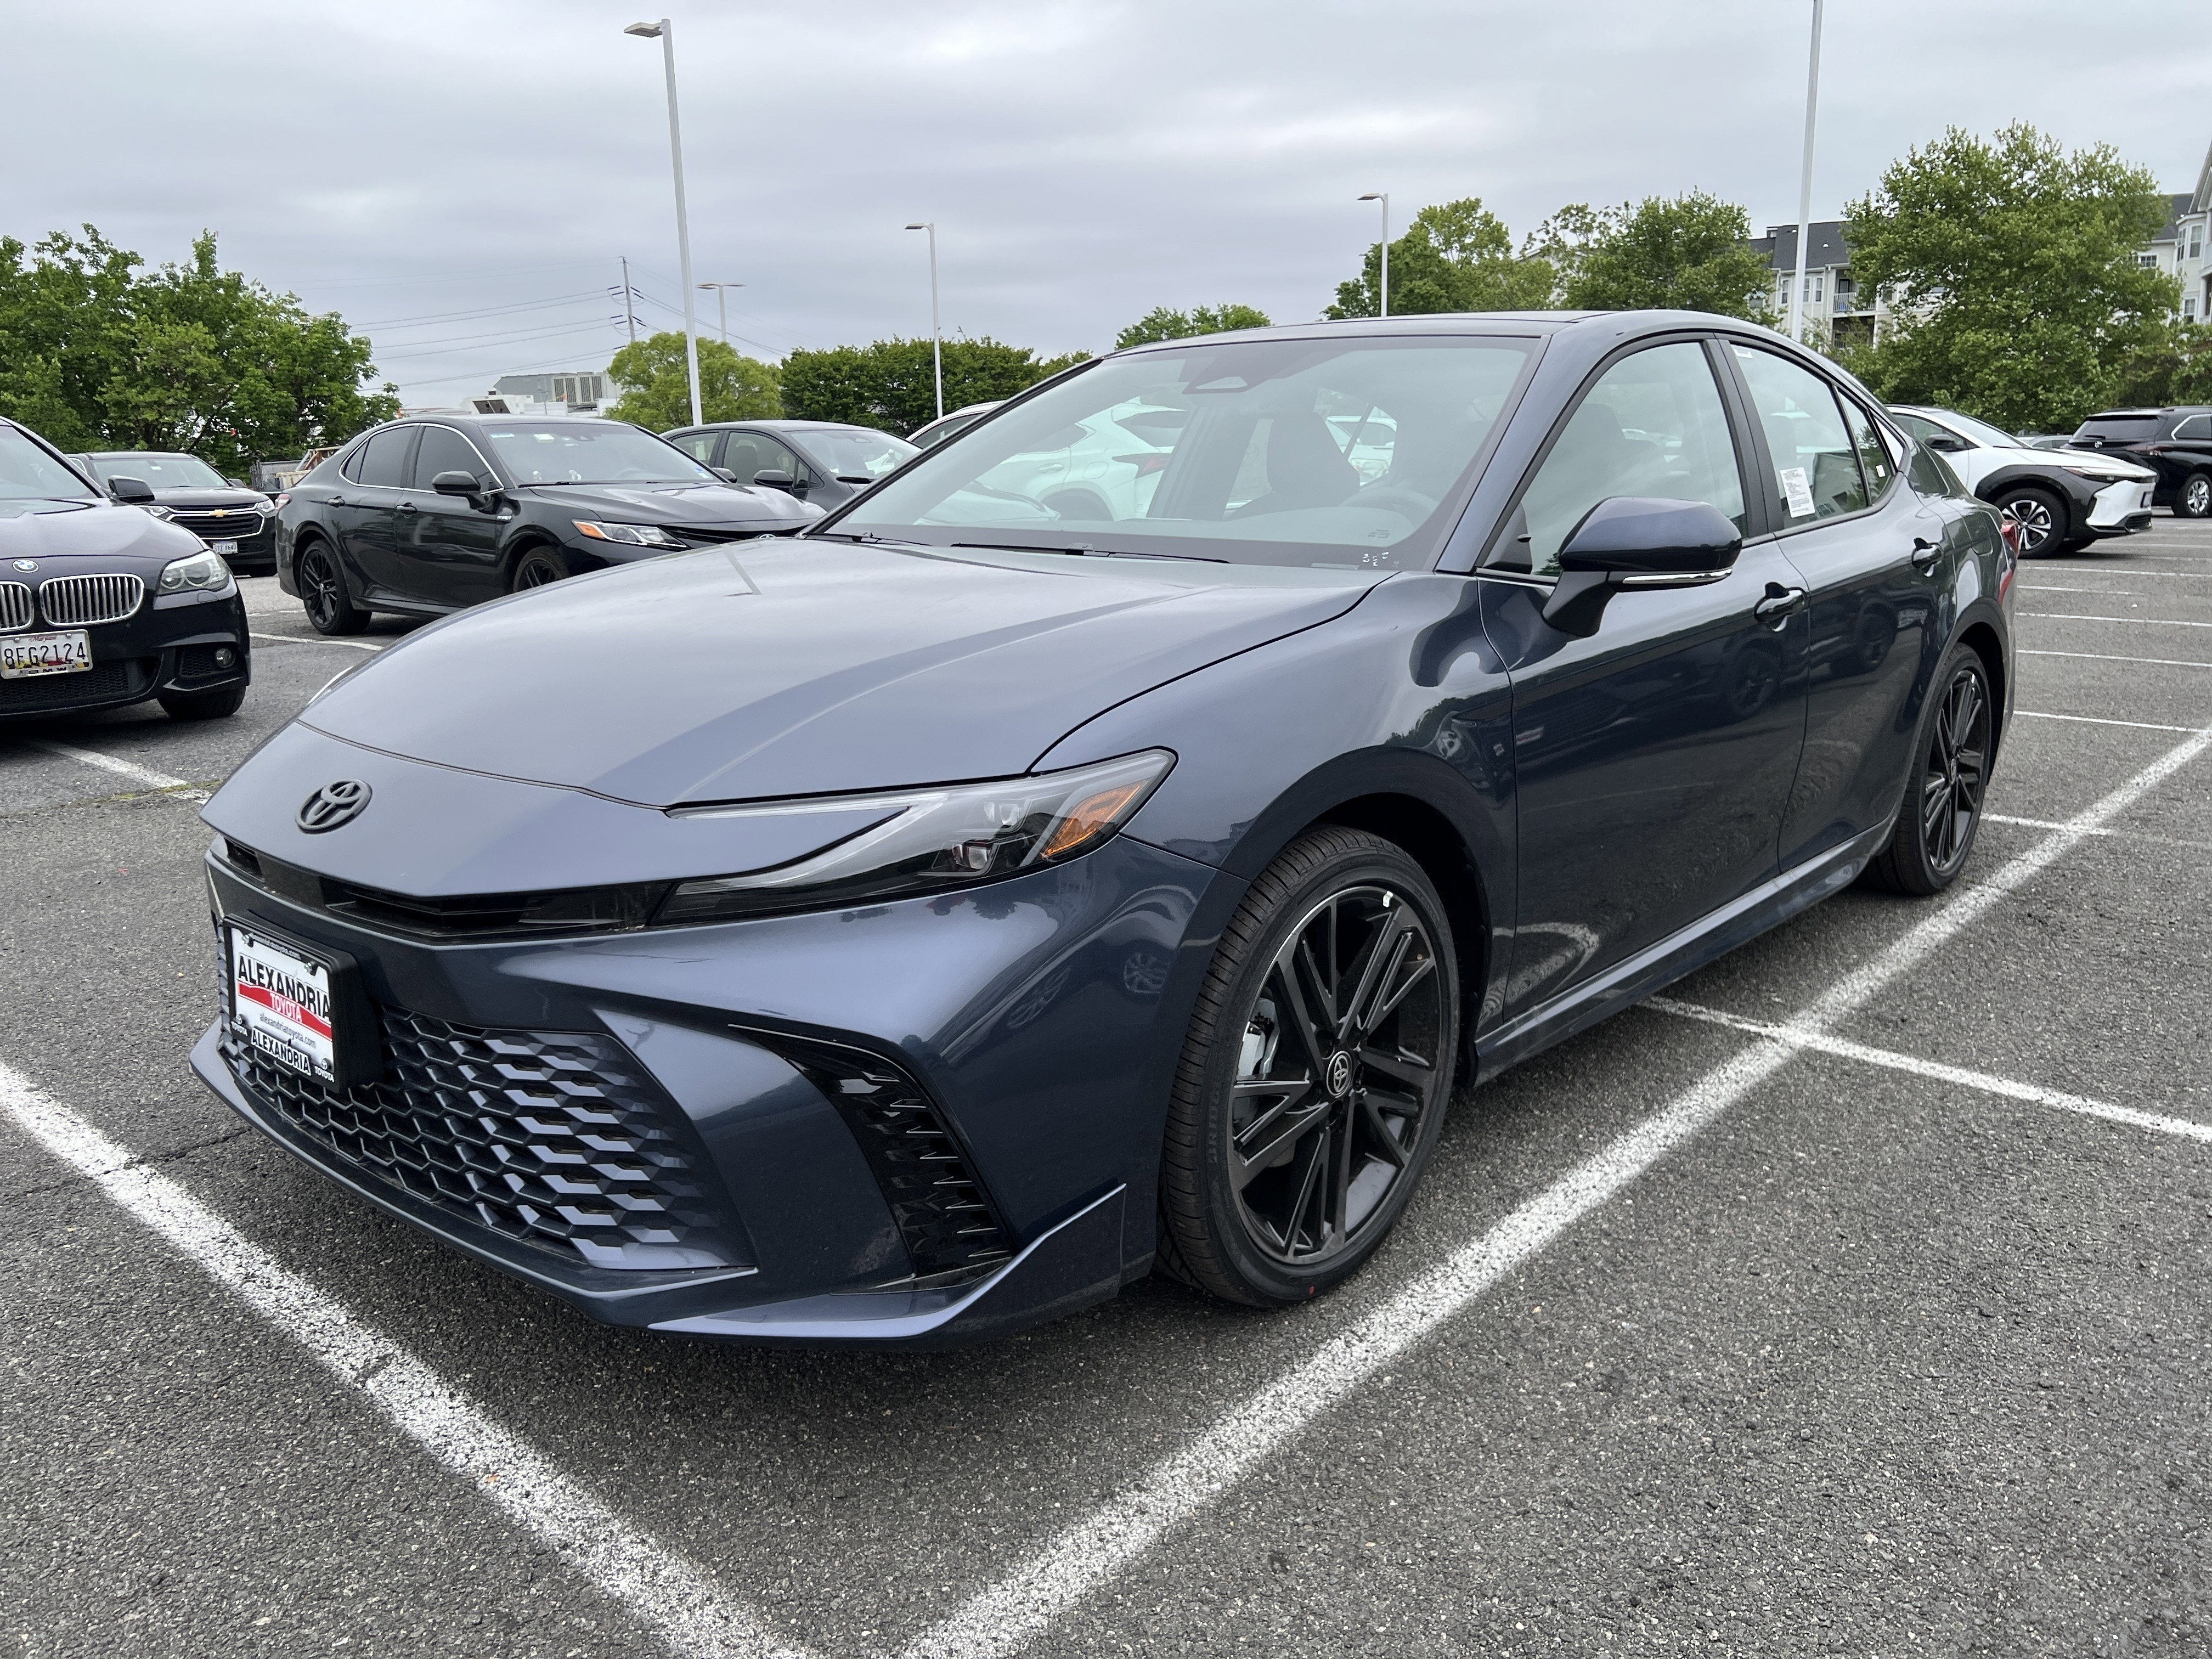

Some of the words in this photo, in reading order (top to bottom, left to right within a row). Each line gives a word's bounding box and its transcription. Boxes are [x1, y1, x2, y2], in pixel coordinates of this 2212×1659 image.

[4, 641, 86, 667] 8FG2124
[238, 955, 331, 1017] ALEXANDRIA
[270, 992, 303, 1022] TOYOTA
[259, 1013, 317, 1048] alexandriatoyota.com
[251, 1028, 311, 1074] ALEXANDRIA
[314, 1066, 335, 1083] TOYOTA
